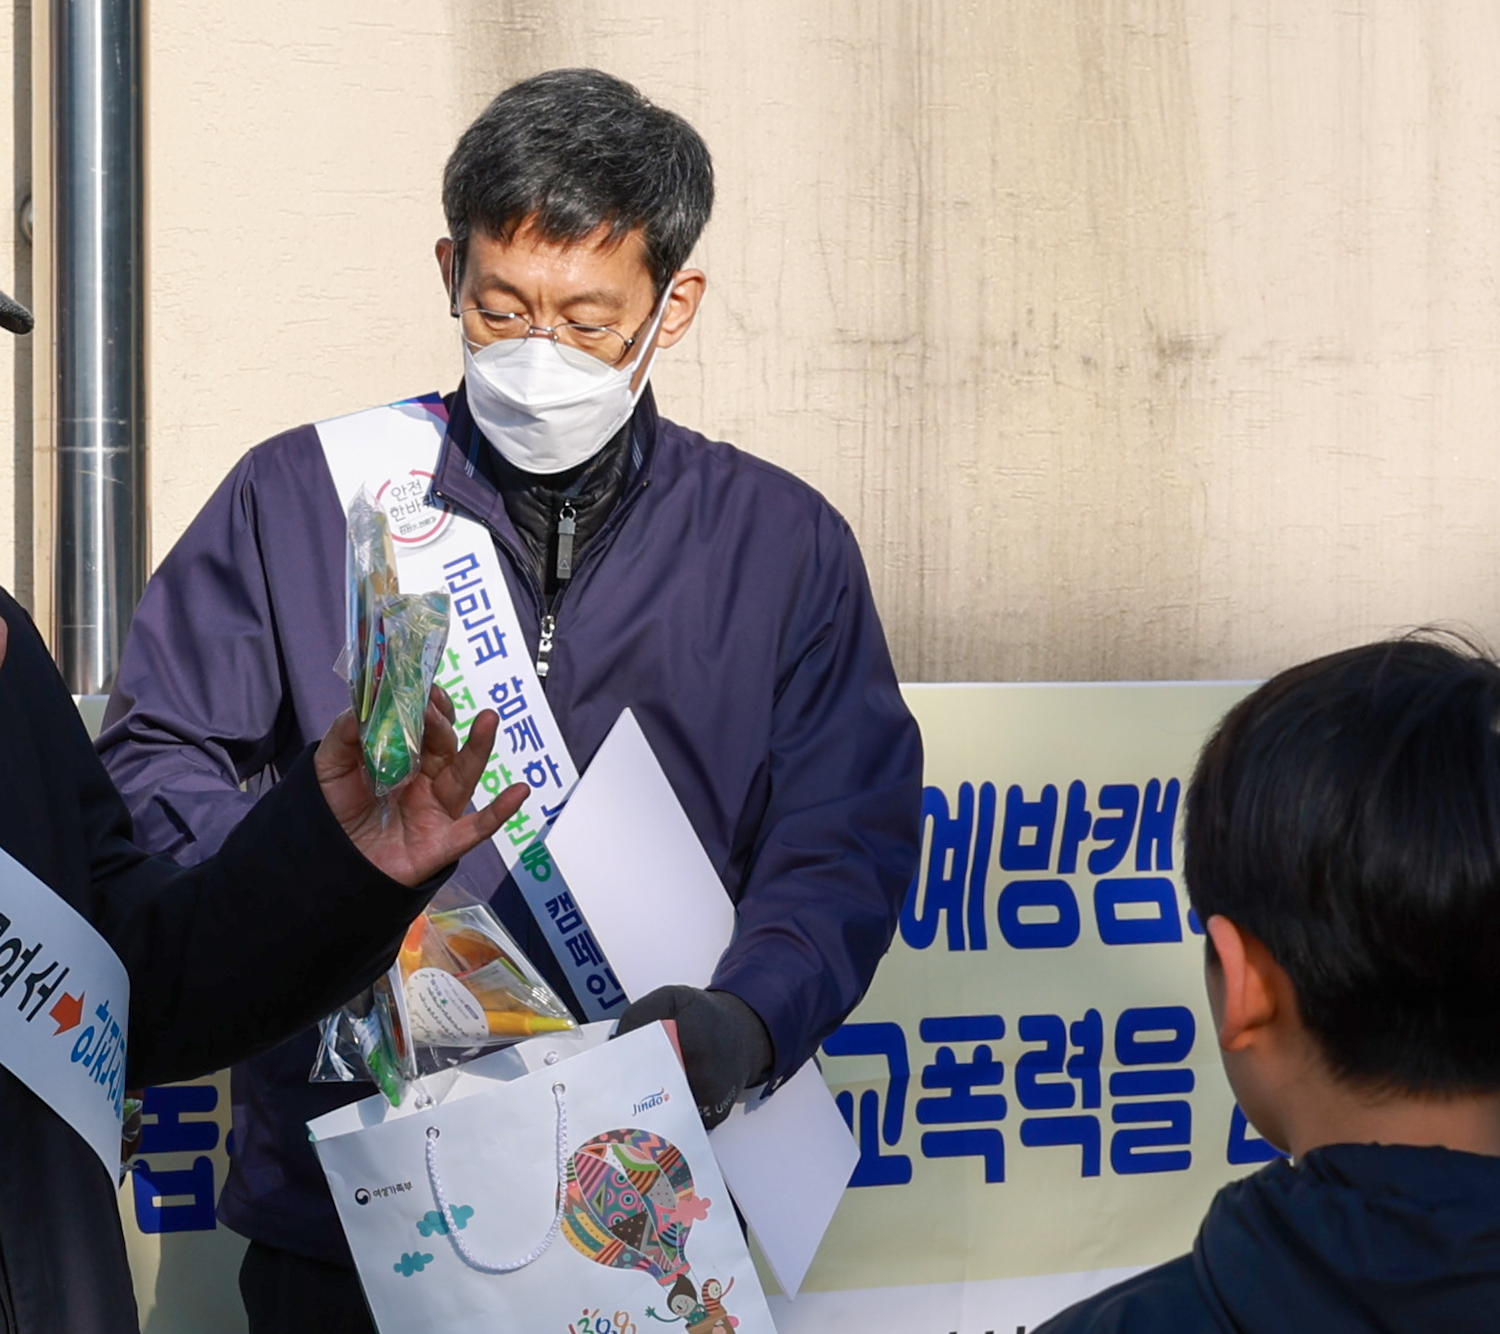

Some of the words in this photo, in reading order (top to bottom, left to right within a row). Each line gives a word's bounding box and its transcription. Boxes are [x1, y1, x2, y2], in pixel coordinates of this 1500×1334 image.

[389, 479, 426, 504] 안전
[442, 552, 510, 667] 군민과
[900, 777, 1207, 952] 예방캠
[544, 890, 627, 1011] 캠페인
[631, 1091, 665, 1117] Jindo
[372, 1180, 414, 1200] 여성가족부
